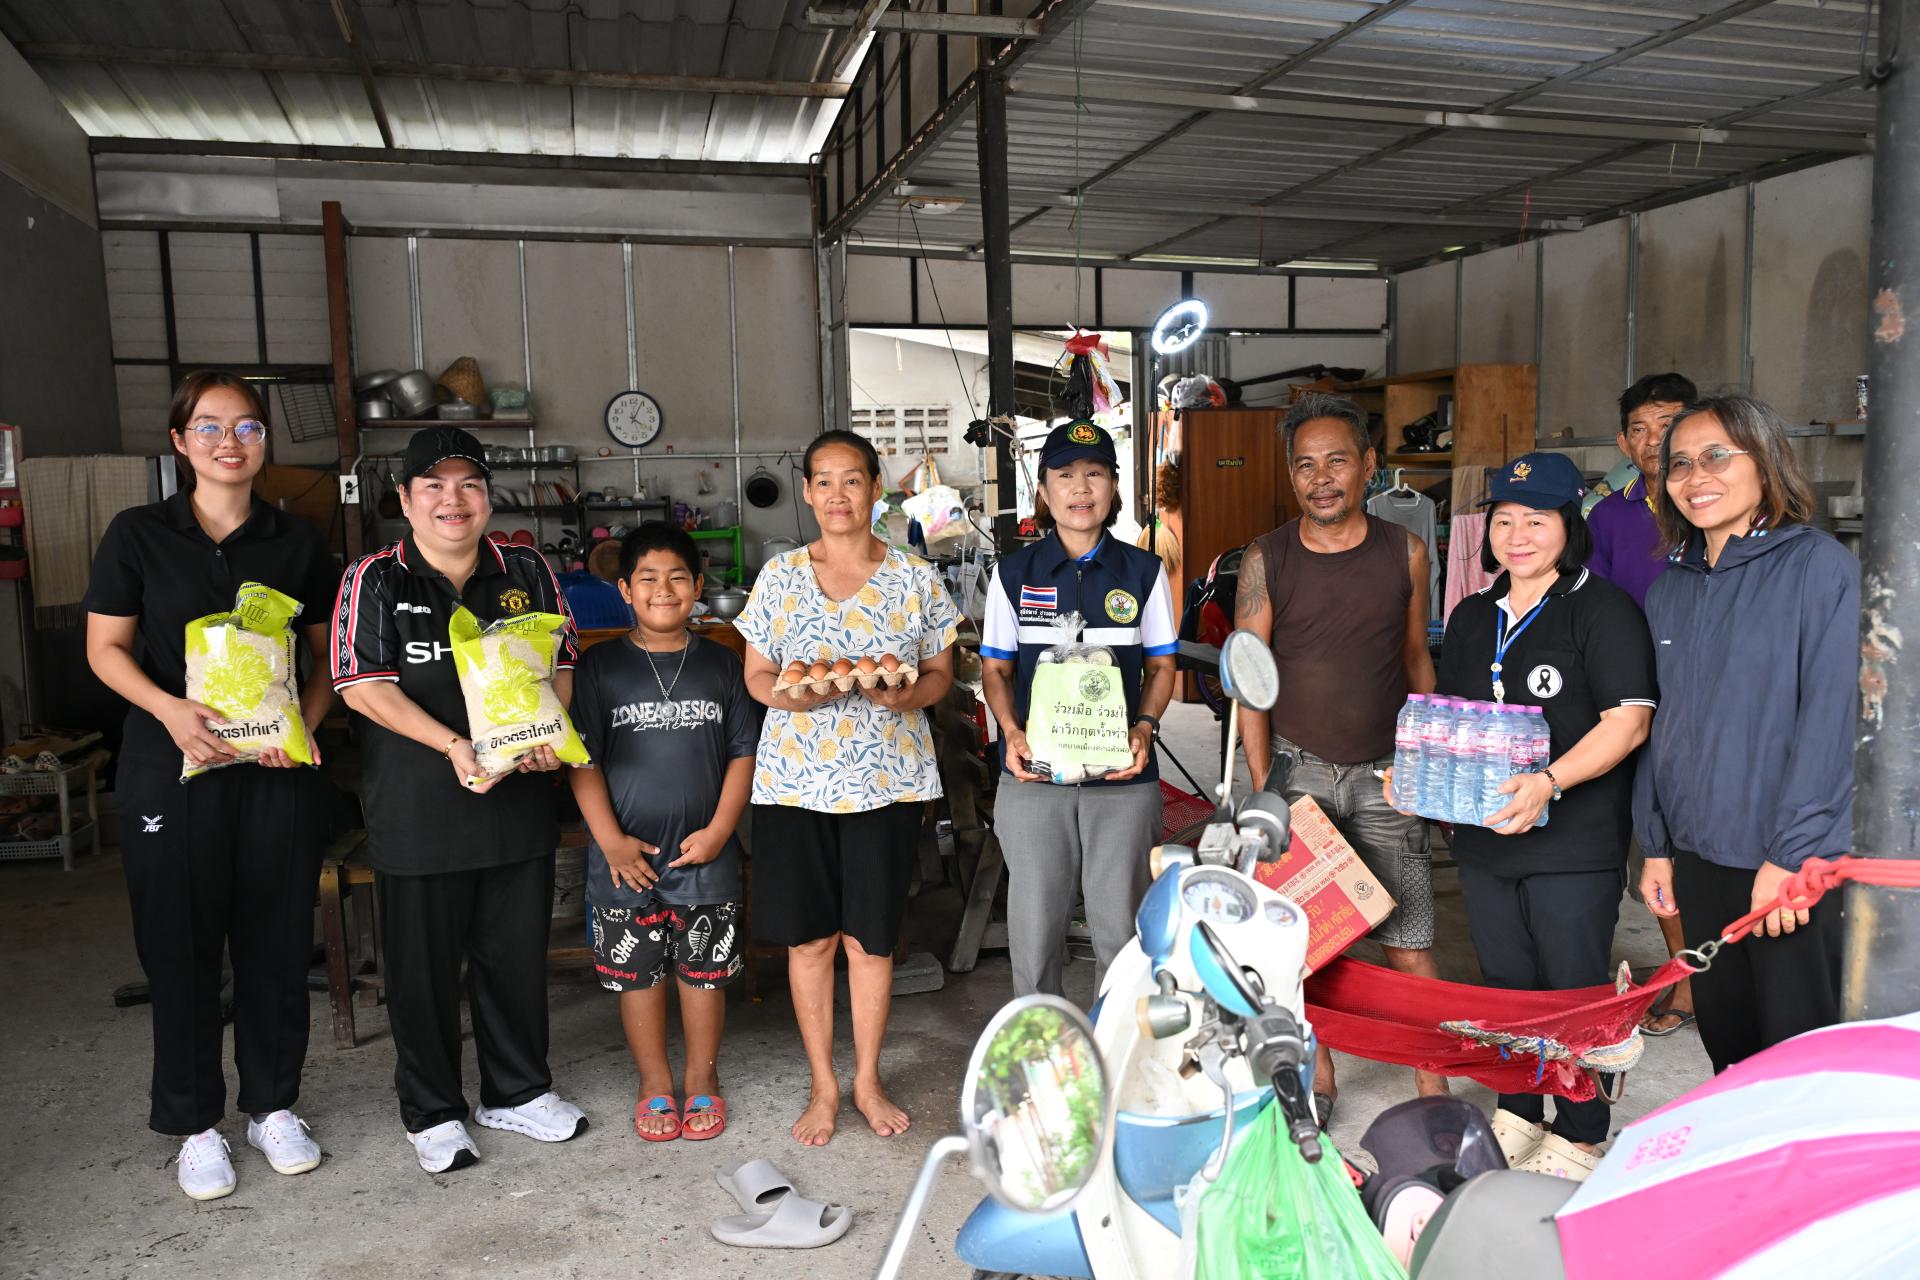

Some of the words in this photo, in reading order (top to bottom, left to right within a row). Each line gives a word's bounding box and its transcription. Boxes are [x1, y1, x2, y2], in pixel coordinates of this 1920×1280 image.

[405, 641, 452, 664] SH
[1097, 704, 1128, 718] ร่วมใ
[208, 721, 280, 738] วตราไก่แจ้
[490, 719, 562, 748] ข้าวตราไก่แจ้
[142, 824, 163, 833] FBT
